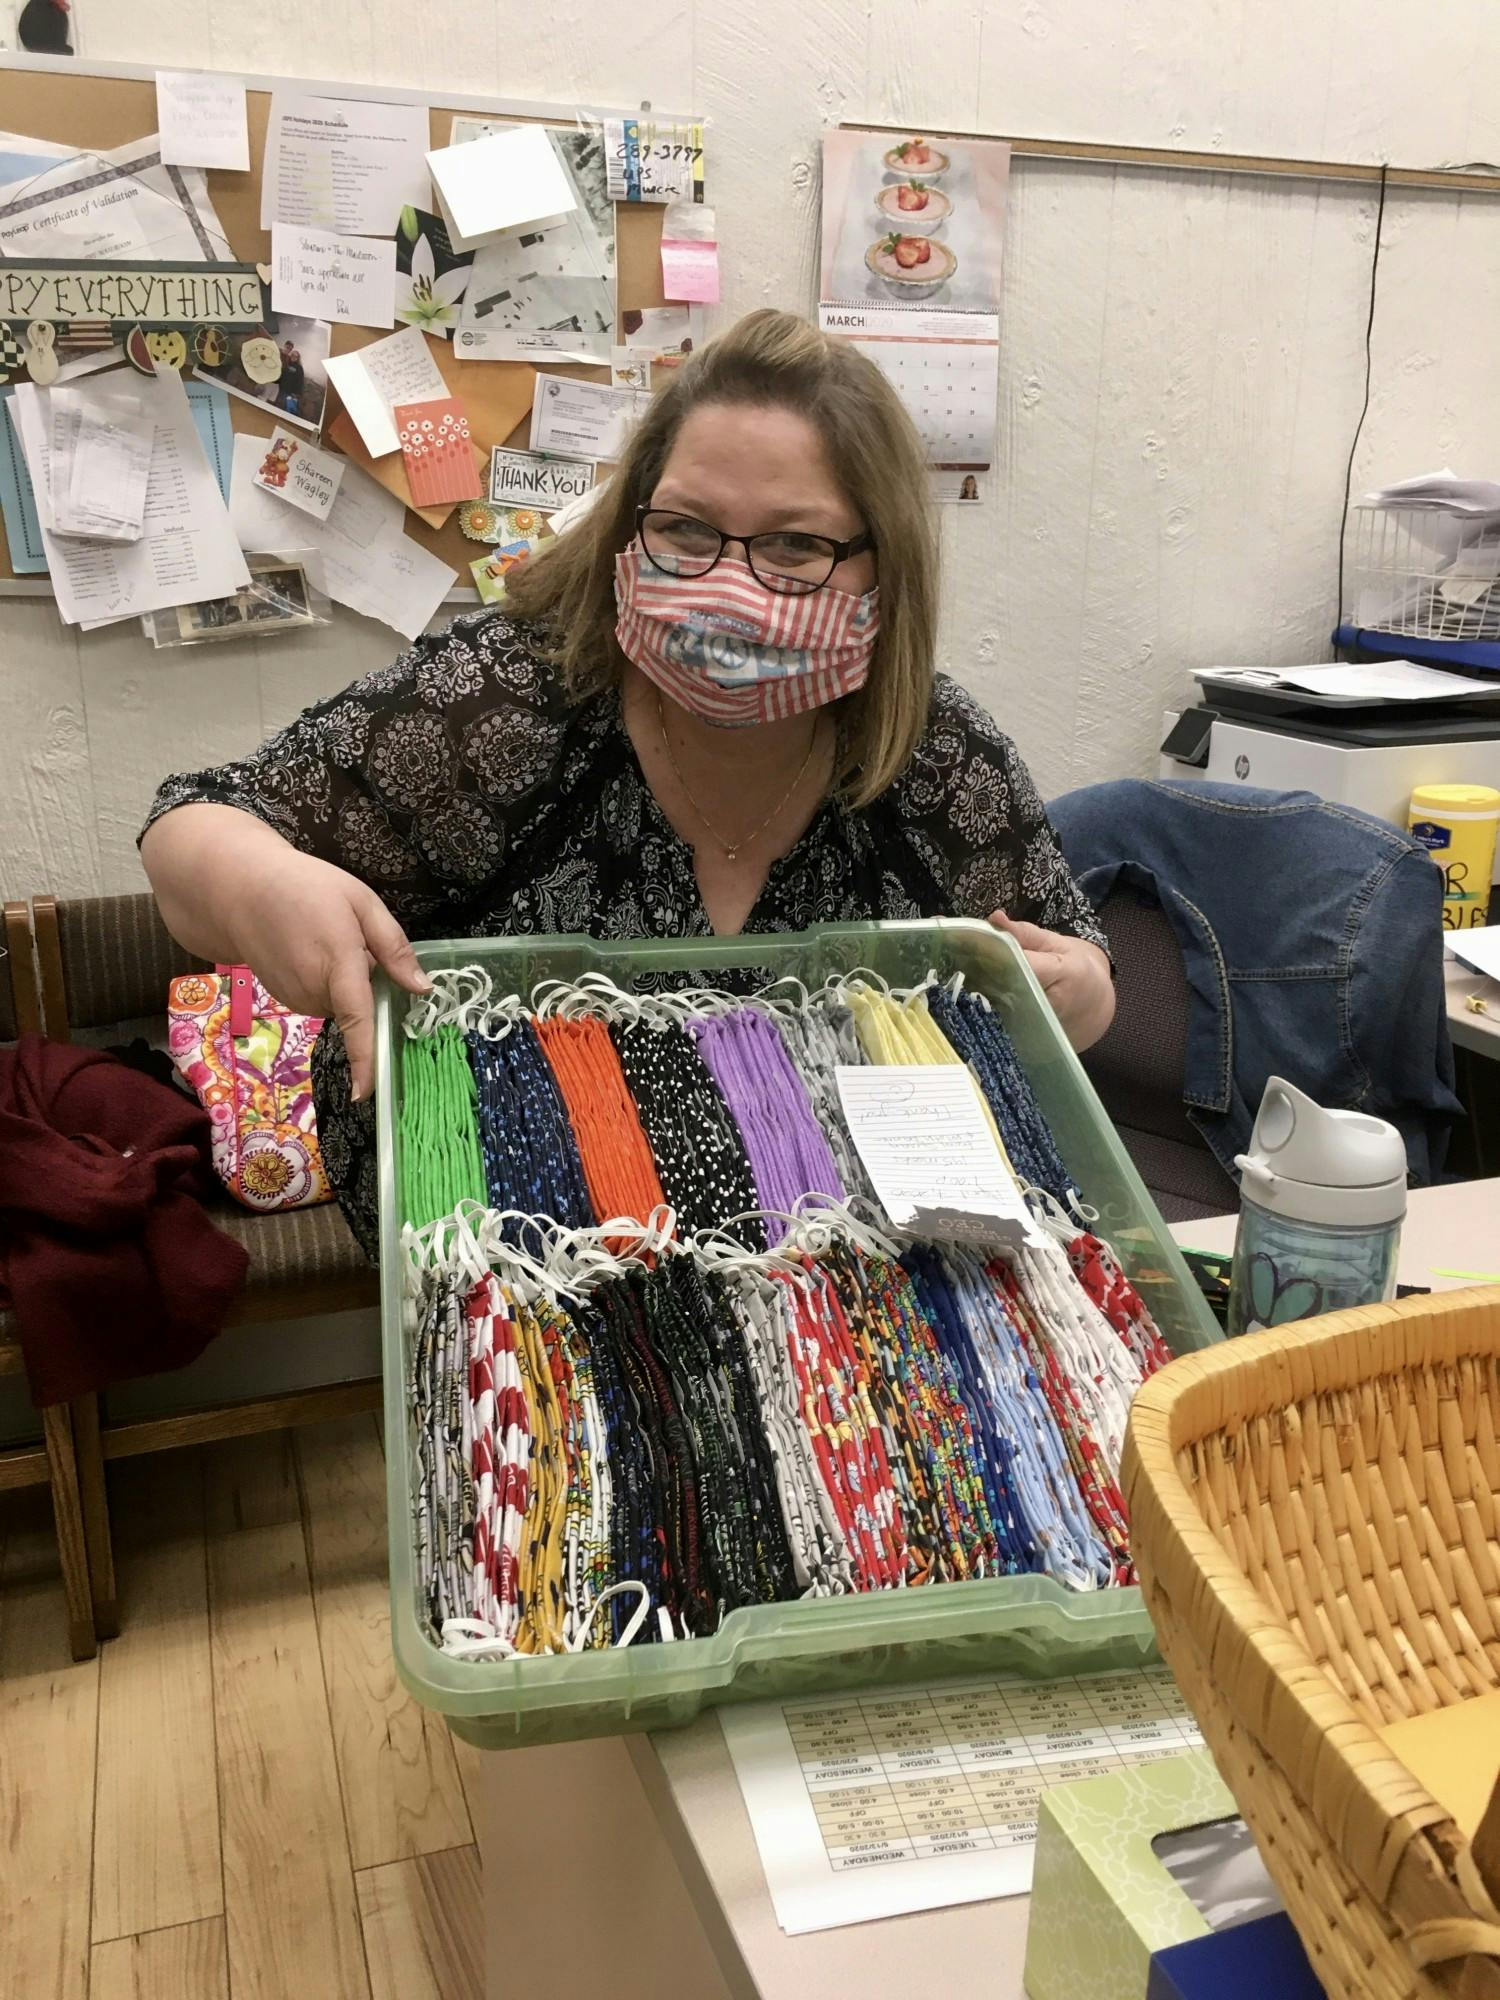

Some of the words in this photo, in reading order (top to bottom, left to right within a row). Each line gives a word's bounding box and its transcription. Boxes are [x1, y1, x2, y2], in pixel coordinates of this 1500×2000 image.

[32, 208, 80, 231] Certificate
[80, 201, 90, 216] of
[91, 188, 139, 209] Validation
[0, 273, 48, 315] PY
[54, 275, 259, 319] EVERYTHING
[826, 315, 865, 327] MARCH
[296, 459, 333, 487] Shareen
[500, 465, 548, 494] THANK
[551, 473, 586, 497] YOU
[294, 475, 331, 506] Wagley
[938, 1218, 985, 1229] CEO
[1128, 1731, 1162, 1740] FRIDAY
[1045, 1739, 1093, 1750] SATURDAY
[972, 1748, 1013, 1759] MONDAY
[898, 1757, 941, 1768] TUESDAY
[814, 1766, 873, 1779] WEDNESDAY
[848, 1809, 866, 1817] OFF
[1006, 1821, 1039, 1830] 11/2020
[928, 1830, 969, 1841] 5/12/2020
[1010, 1832, 1038, 1841] NDAY
[848, 1841, 888, 1852] 5/13/2020
[930, 1840, 977, 1853] TUESDAY
[841, 1851, 904, 1865] WEDNESDAY
